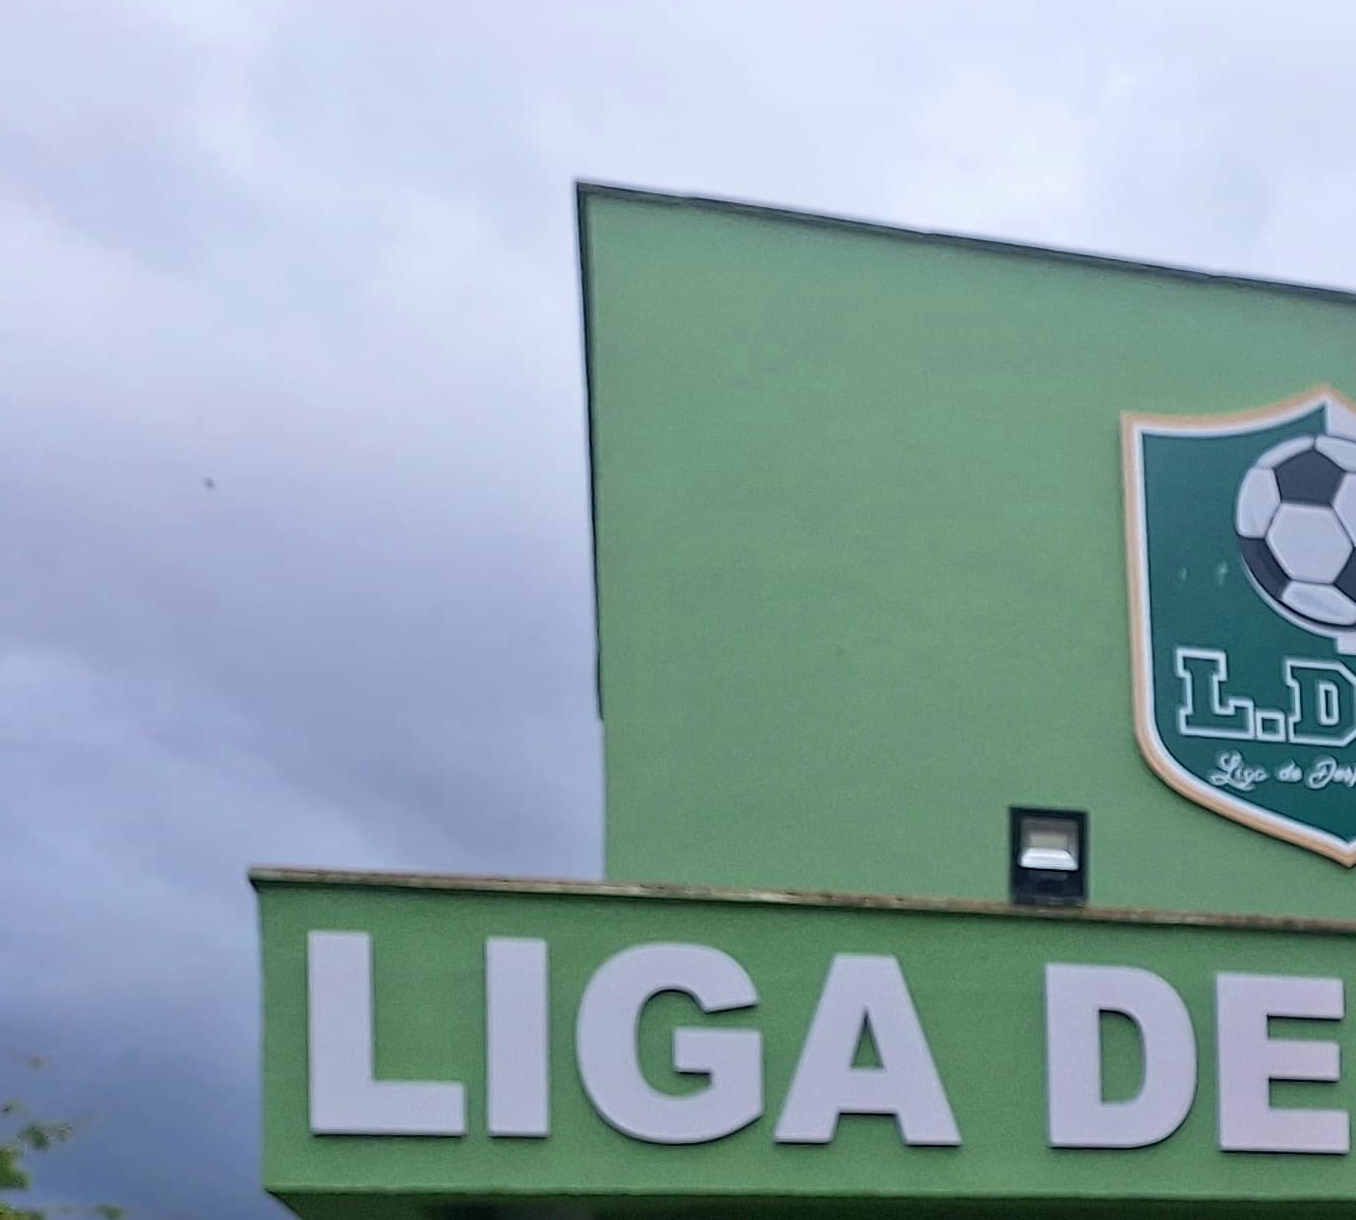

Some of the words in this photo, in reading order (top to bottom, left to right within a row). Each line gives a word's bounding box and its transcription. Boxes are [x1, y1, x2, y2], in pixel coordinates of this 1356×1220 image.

[1209, 750, 1268, 791] Liga
[1277, 759, 1302, 782] de
[306, 928, 965, 1146] LIGA
[1042, 960, 1351, 1153] DE
